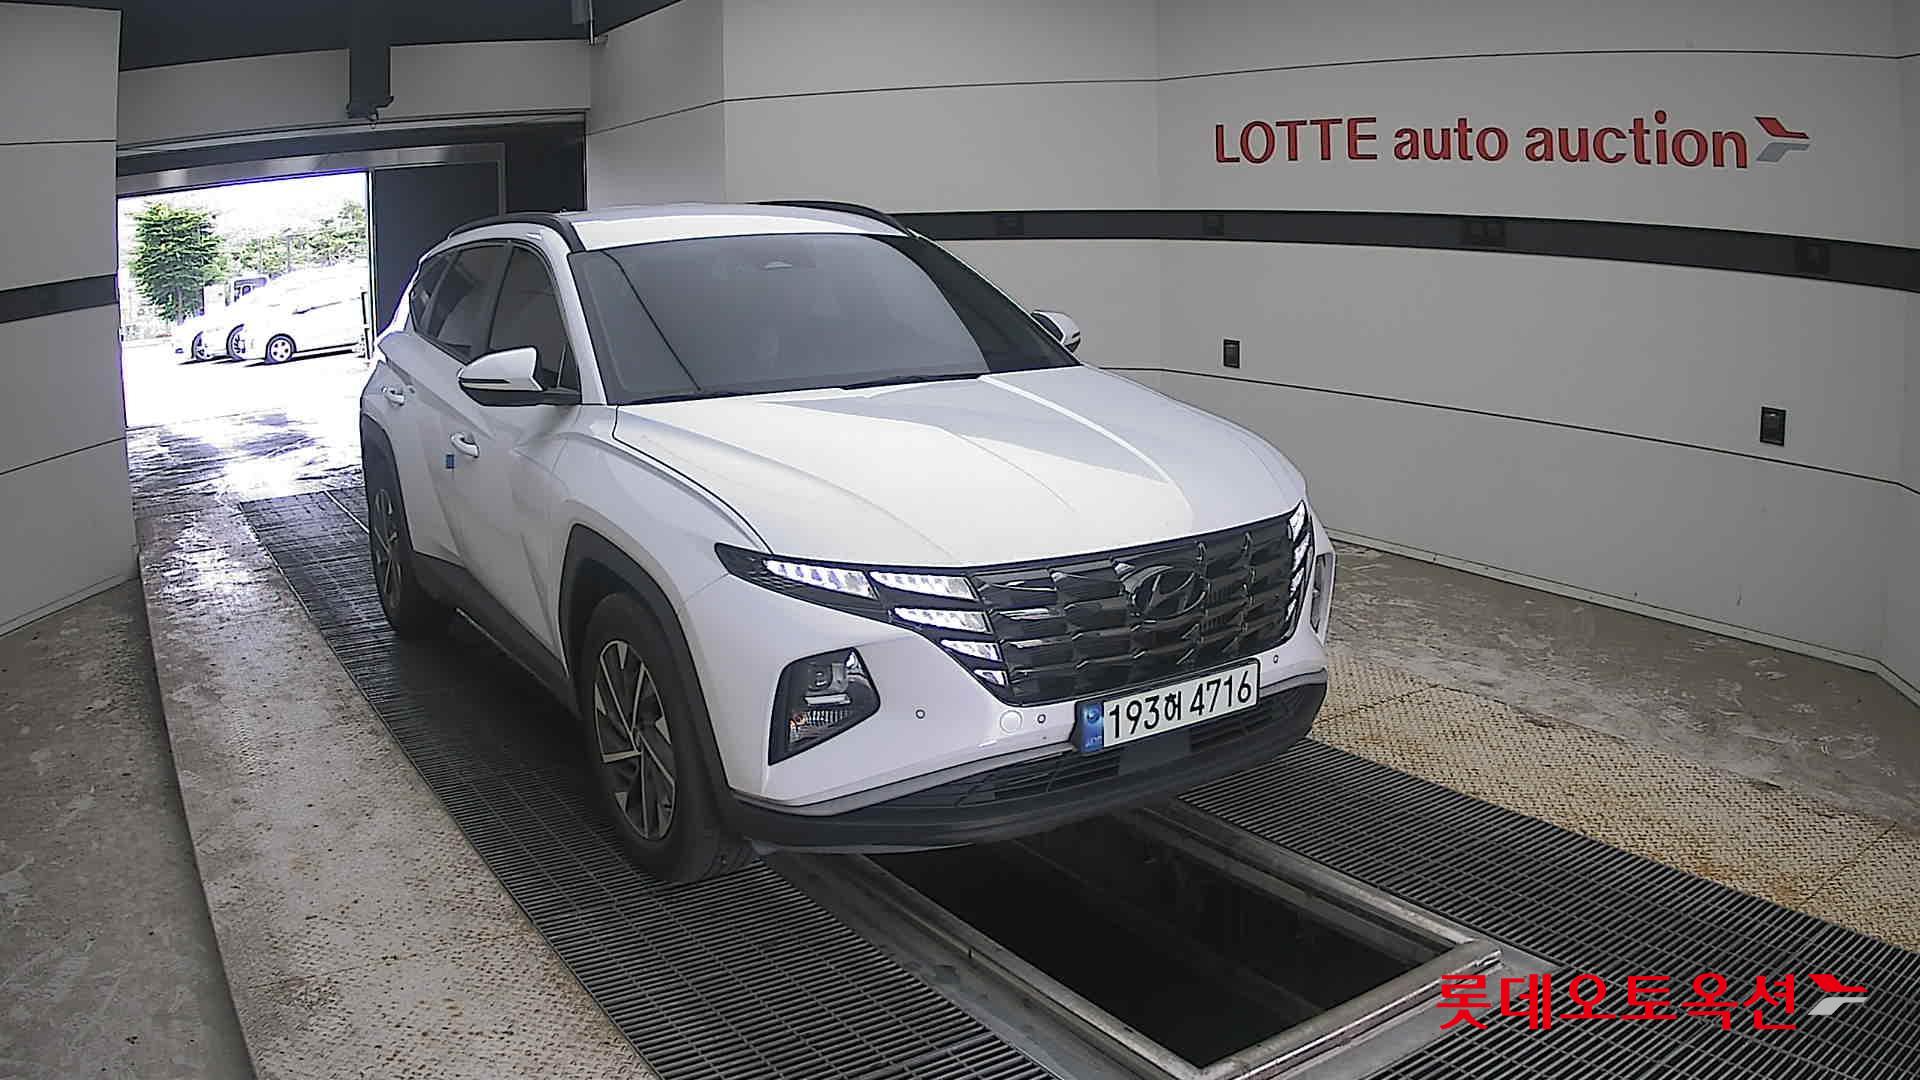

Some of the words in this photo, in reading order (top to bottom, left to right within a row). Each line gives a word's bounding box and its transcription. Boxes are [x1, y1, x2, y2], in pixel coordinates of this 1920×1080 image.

[1215, 117, 1377, 164] LOTTE
[1394, 118, 1508, 162] auto
[1525, 110, 1748, 169] auction
[1109, 690, 1182, 738] 193허
[1189, 670, 1251, 716] 4716
